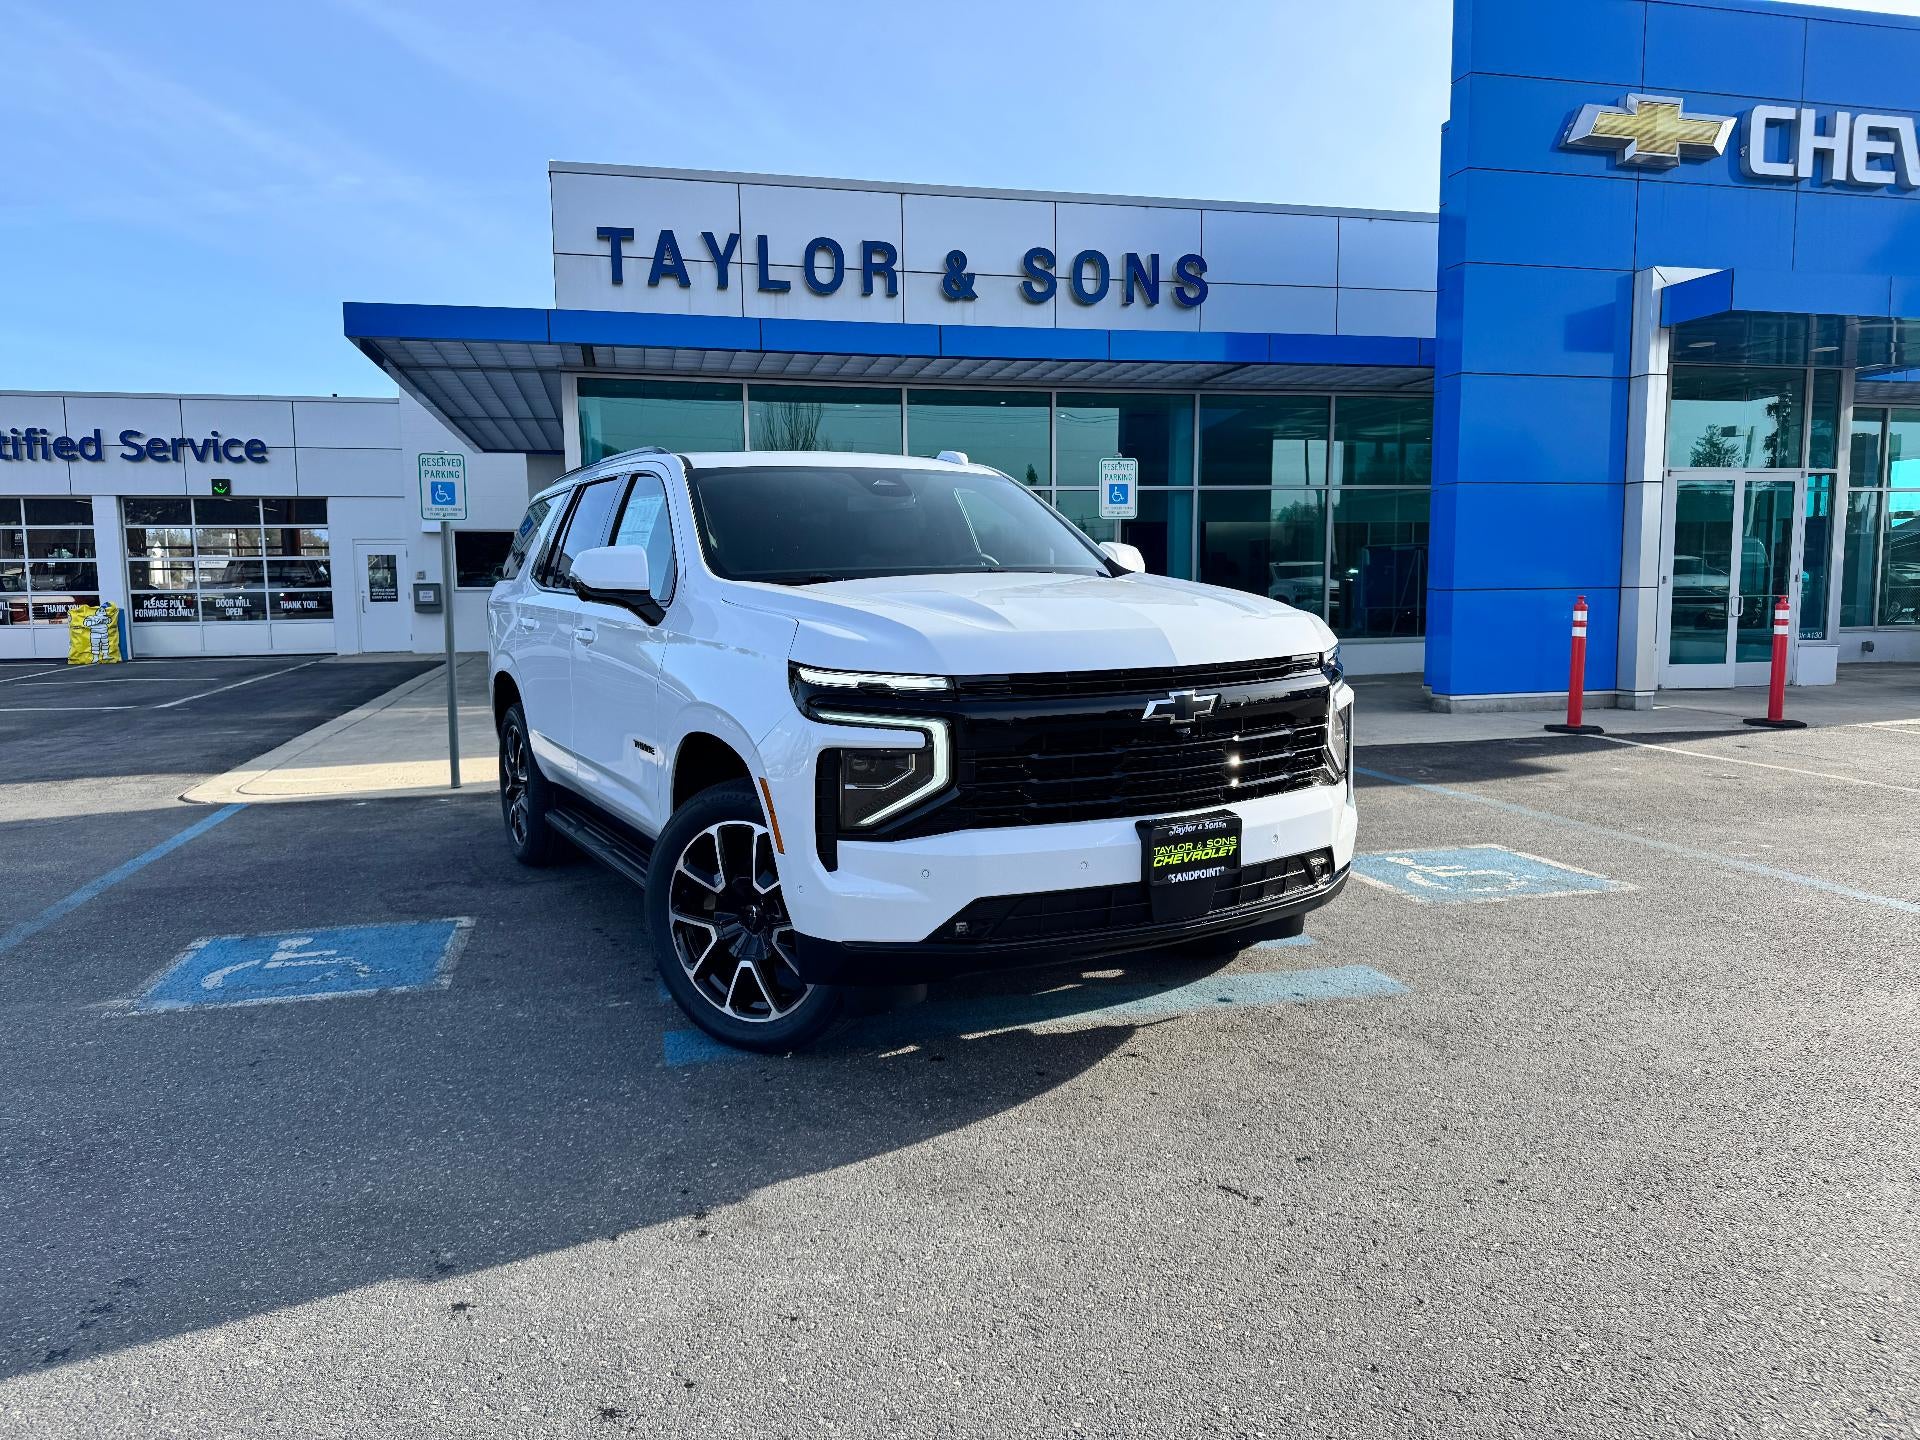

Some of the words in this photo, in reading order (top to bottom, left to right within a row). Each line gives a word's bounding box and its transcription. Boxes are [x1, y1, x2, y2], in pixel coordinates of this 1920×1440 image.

[596, 226, 899, 297] TAYLOR
[940, 249, 978, 300] &
[1019, 246, 1210, 307] SONS
[118, 429, 268, 463] Service
[421, 457, 462, 467] RESERVED
[1103, 463, 1134, 471] RESERVED
[424, 470, 460, 479] PARKING
[1104, 473, 1133, 481] PARKING
[143, 599, 169, 608] PLEASE
[170, 599, 187, 608] PULL
[215, 598, 235, 608] DOOR
[235, 598, 252, 607] WILL
[280, 600, 302, 609] THANK
[303, 600, 318, 609] YOU!
[43, 604, 67, 614] THANK
[134, 608, 168, 618] FORWARD
[169, 608, 195, 617] SLOWLY
[225, 607, 243, 616] OPEN
[1173, 825, 1196, 835] Taylor
[1204, 821, 1222, 830] Sons
[1154, 843, 1193, 856] TAYLOR
[1196, 841, 1204, 851] &
[1207, 837, 1237, 848] SONS
[1153, 845, 1237, 868] CHEVROLET
[1171, 867, 1221, 883] SANDPOINT
